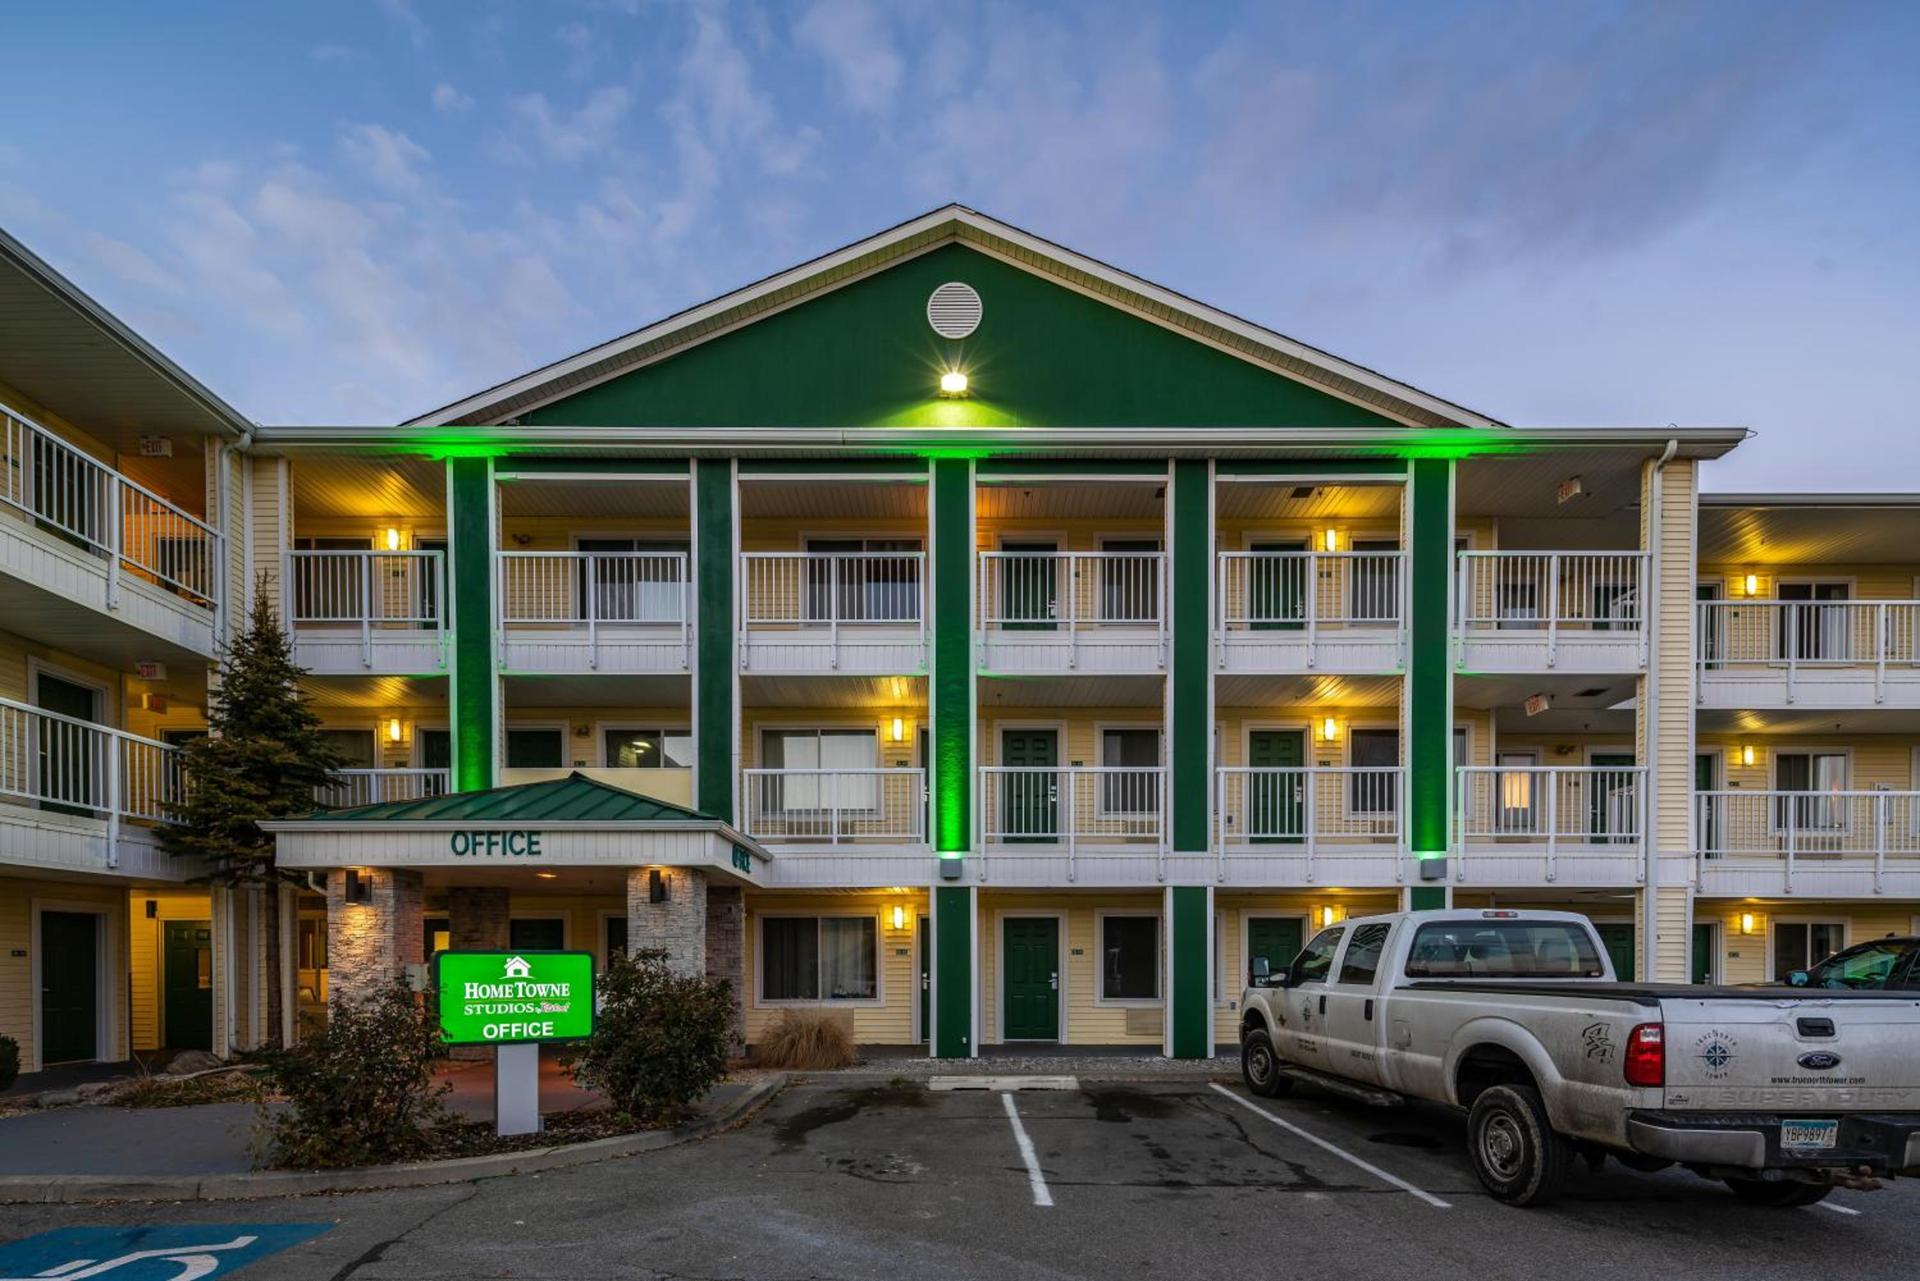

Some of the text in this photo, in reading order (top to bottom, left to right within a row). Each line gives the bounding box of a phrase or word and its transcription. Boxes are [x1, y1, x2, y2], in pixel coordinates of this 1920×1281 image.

[450, 830, 542, 856] OFFICE
[464, 1003, 534, 1016] STUDIOS
[483, 1022, 554, 1039] OFFICE
[1809, 1052, 1834, 1066] Ford
[1718, 1089, 1814, 1105] SUPER
